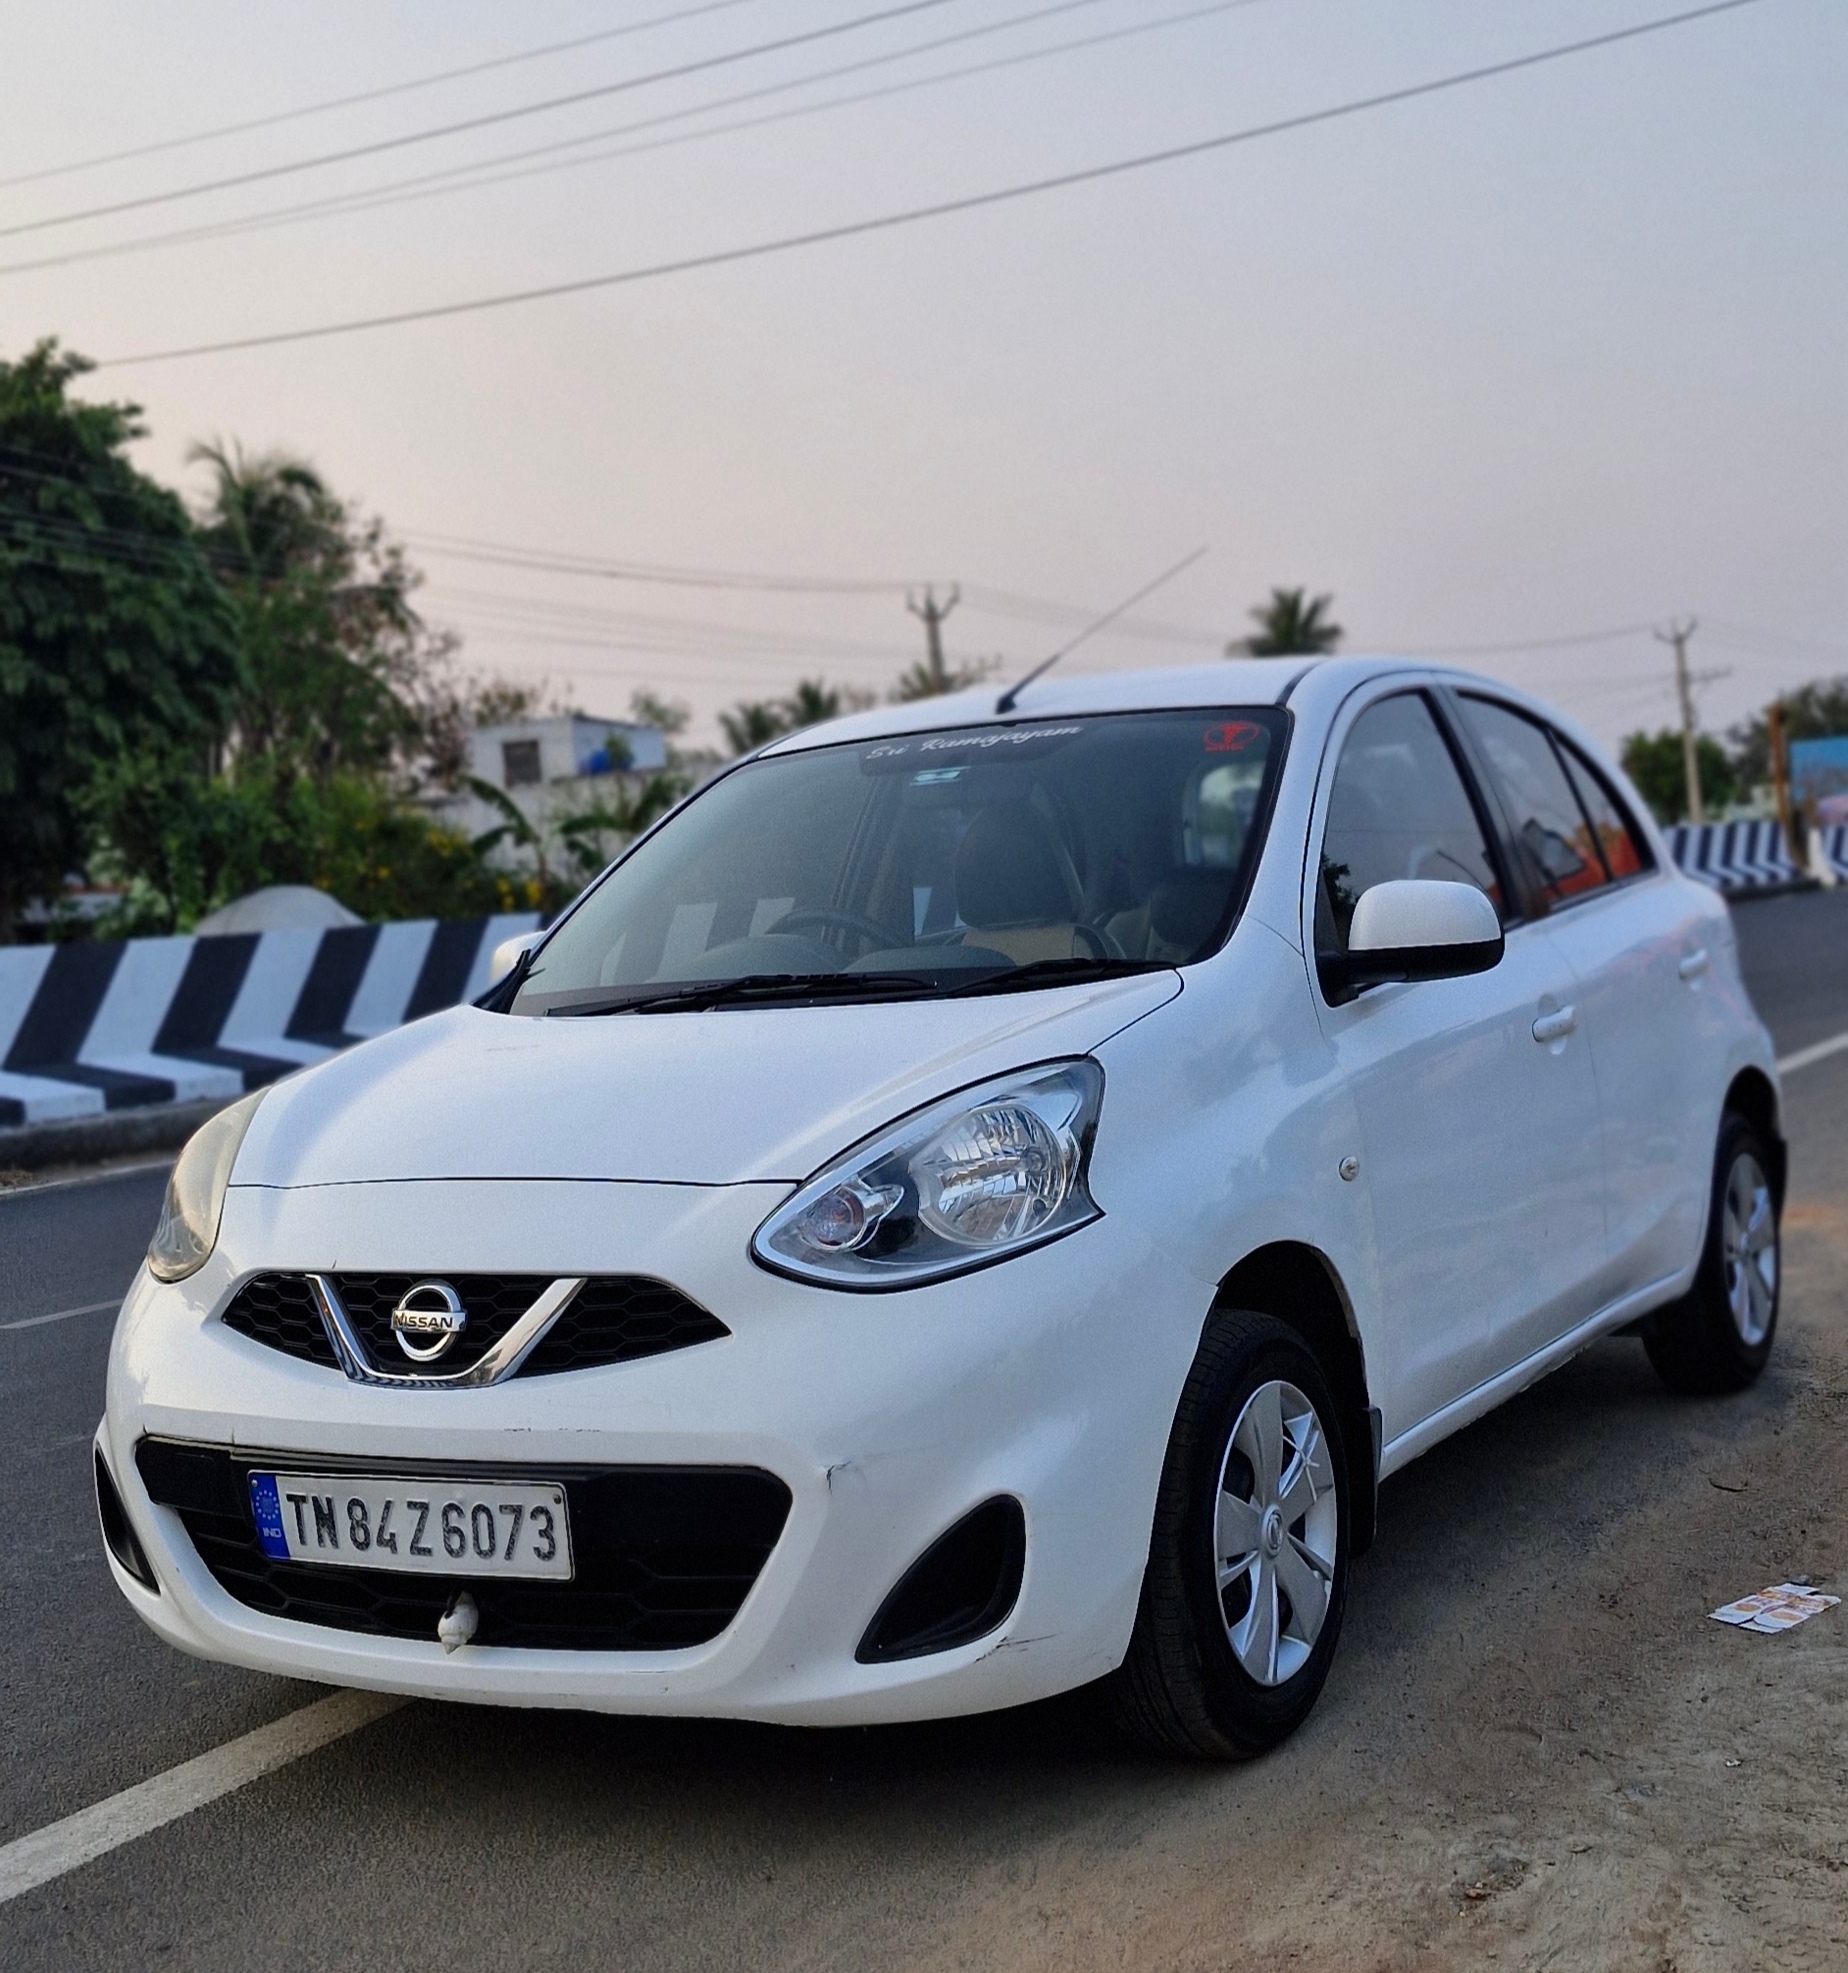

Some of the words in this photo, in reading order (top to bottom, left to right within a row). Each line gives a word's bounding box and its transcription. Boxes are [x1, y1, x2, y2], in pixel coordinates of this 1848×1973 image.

[866, 744, 910, 759] Sri
[393, 1312, 453, 1329] NISSAN
[262, 1527, 282, 1538] IND
